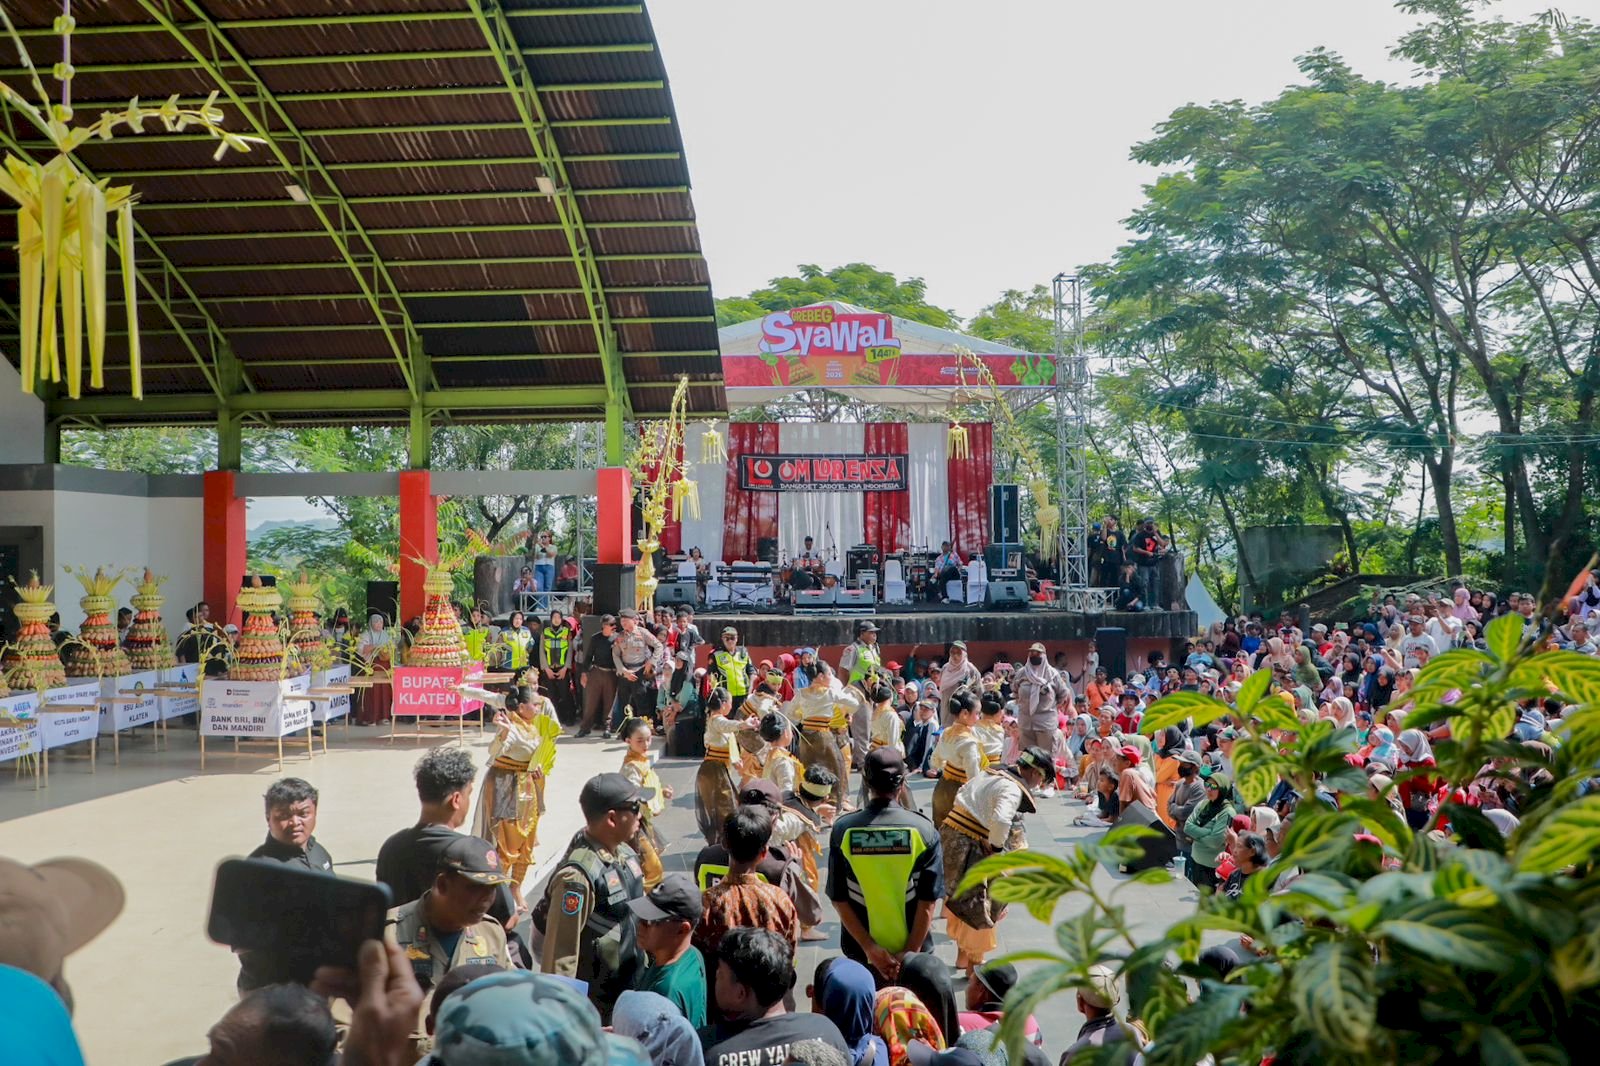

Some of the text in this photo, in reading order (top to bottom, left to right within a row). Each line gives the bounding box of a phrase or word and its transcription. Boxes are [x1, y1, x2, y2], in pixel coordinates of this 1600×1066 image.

[791, 308, 833, 323] GREBEG
[778, 460, 811, 482] OM
[402, 676, 455, 689] BUPAT
[399, 692, 456, 705] KLATEN
[129, 711, 149, 722] KLATEN
[211, 715, 232, 723] BANK
[234, 716, 251, 724] BRI,
[230, 724, 264, 732] MANDIRI
[851, 831, 909, 848] RAPI
[719, 1049, 761, 1066] CREW
